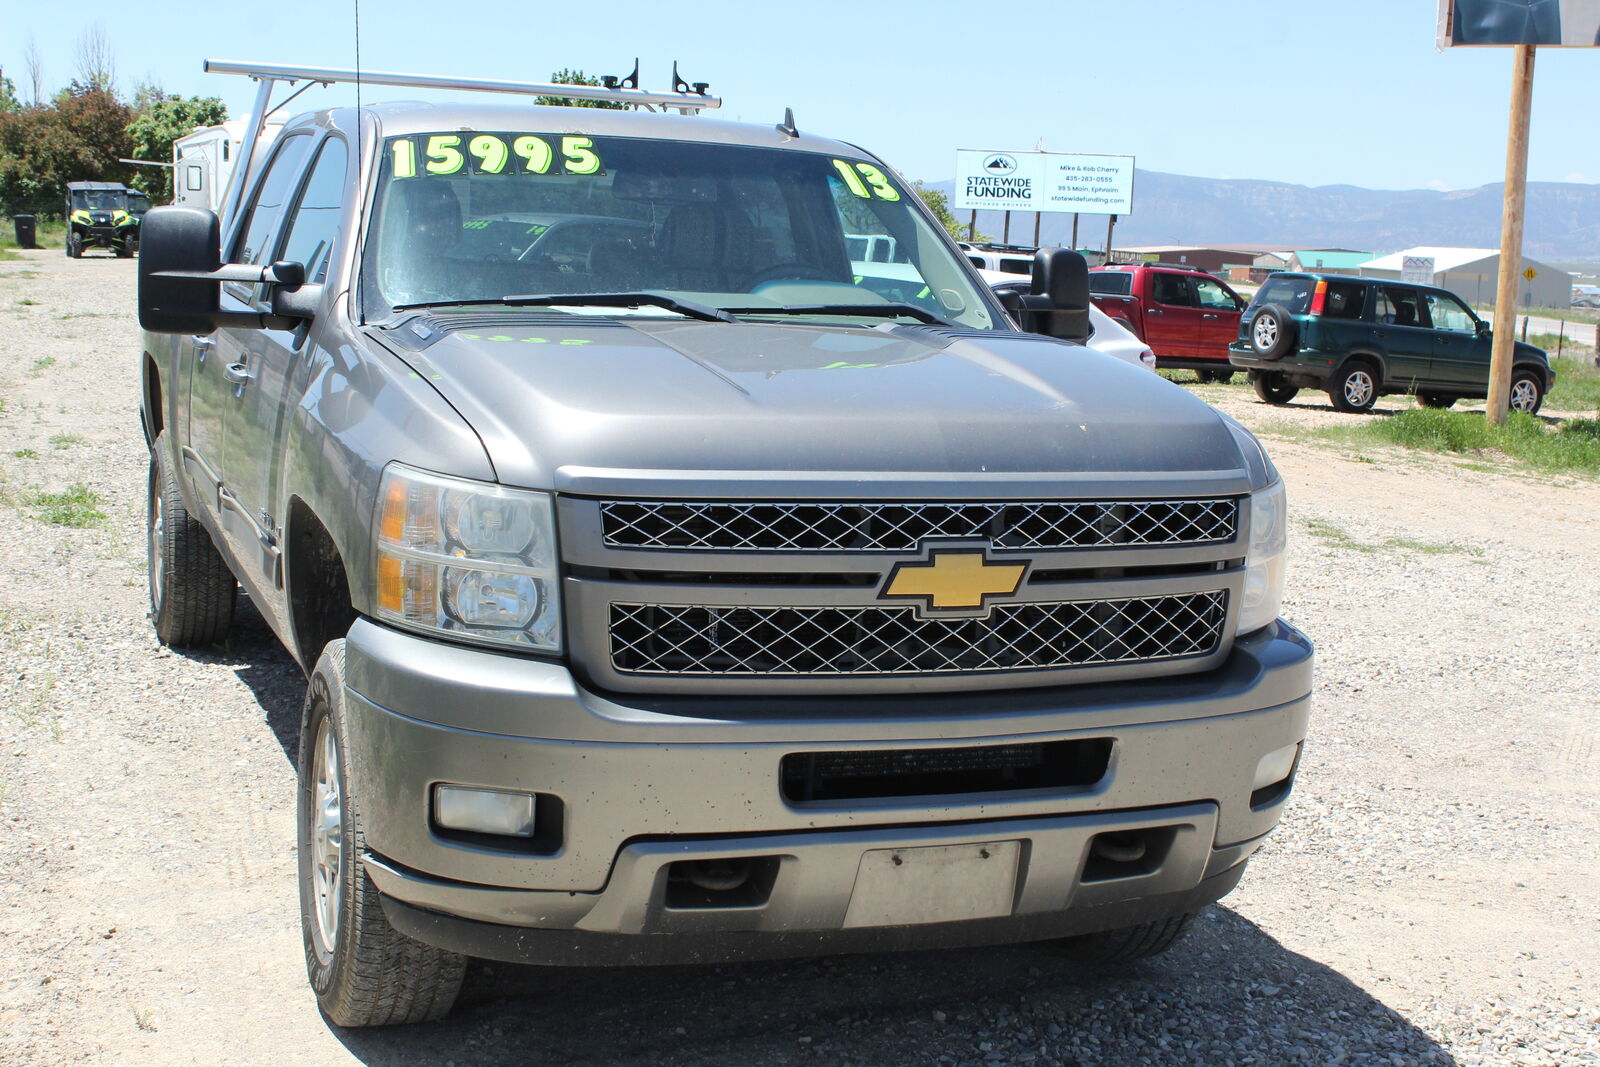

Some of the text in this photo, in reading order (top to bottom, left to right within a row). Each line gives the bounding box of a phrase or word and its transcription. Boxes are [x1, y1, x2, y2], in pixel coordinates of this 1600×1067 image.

[392, 135, 600, 177] 15995
[1096, 166, 1120, 174] Cherry
[832, 159, 900, 202] 13
[967, 176, 1031, 187] STATEWIDE
[966, 186, 1031, 199] FUNDING
[1051, 195, 1125, 205] statewidefunding.com
